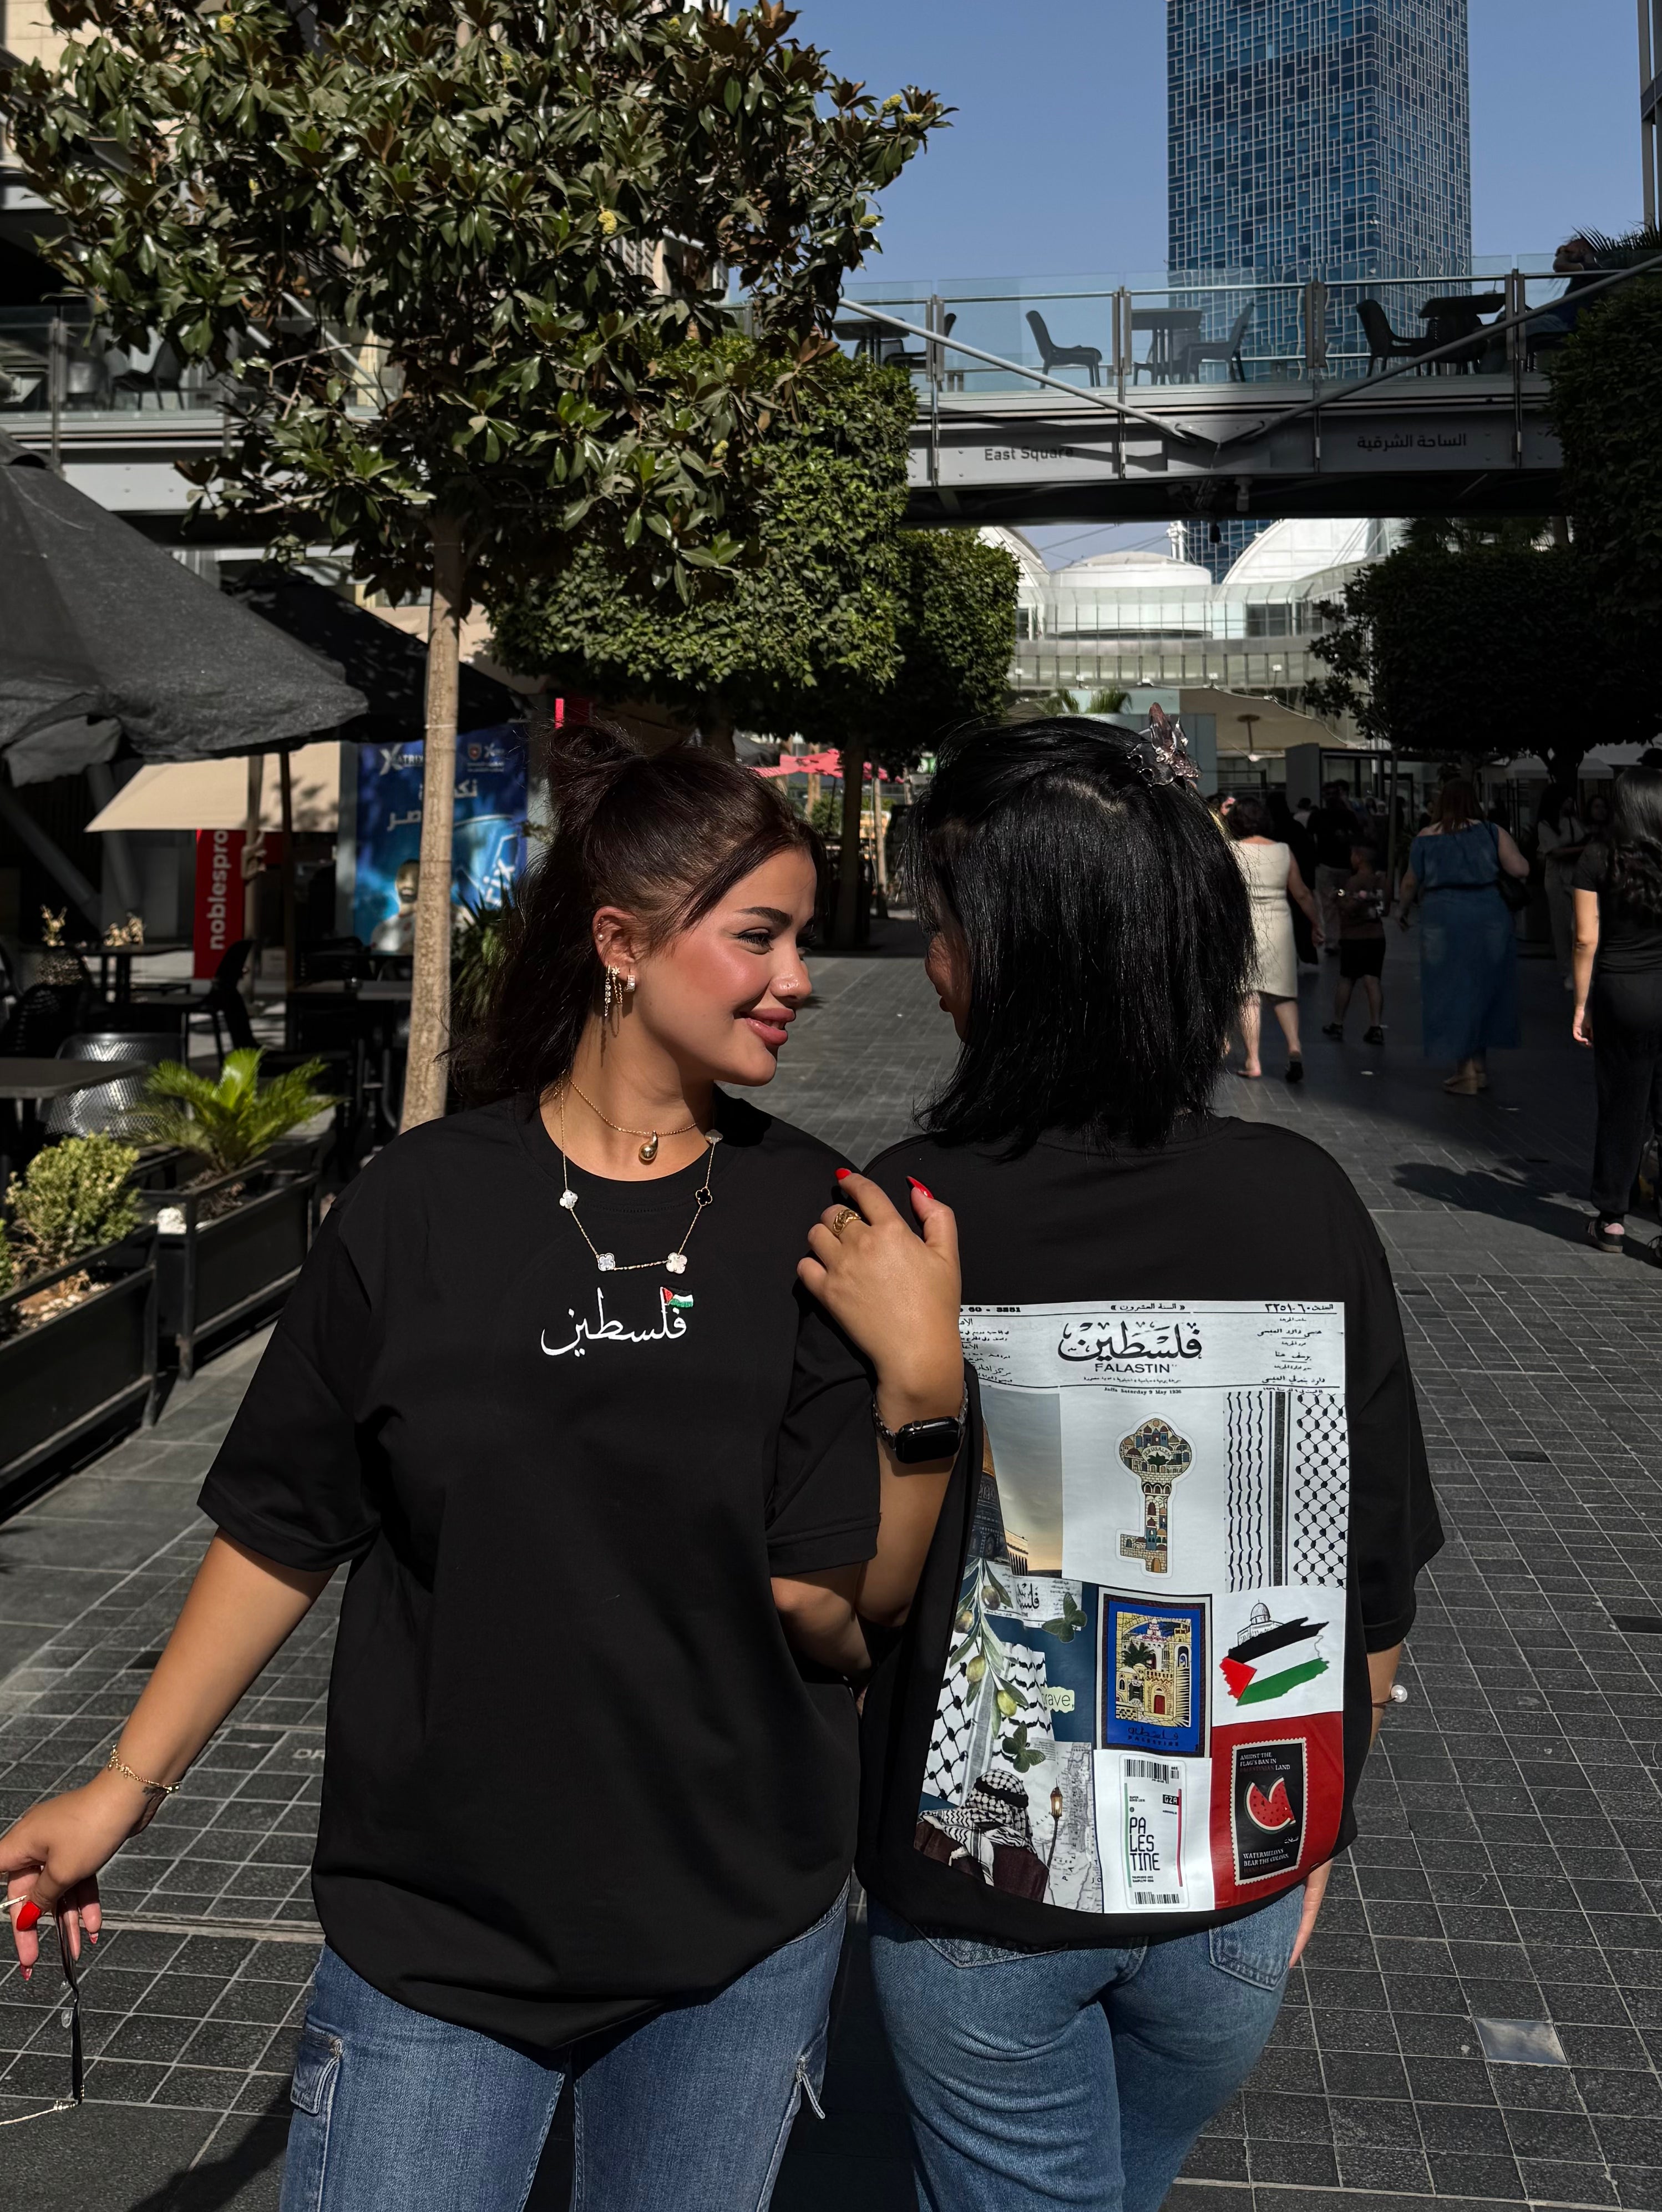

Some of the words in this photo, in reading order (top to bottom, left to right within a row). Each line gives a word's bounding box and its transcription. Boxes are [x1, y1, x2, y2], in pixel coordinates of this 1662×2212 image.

[1357, 433, 1413, 452] الشرقية
[1416, 433, 1466, 447] الساحة
[985, 448, 1016, 461] East
[1021, 446, 1074, 462] Square
[540, 1286, 687, 1357] فلسطين
[1095, 1363, 1170, 1373] FALASTIN
[1129, 1816, 1146, 1834] PA
[1129, 1834, 1154, 1852] LES
[1129, 1852, 1160, 1871] TINE
[1243, 1849, 1284, 1859] WATERMELONS
